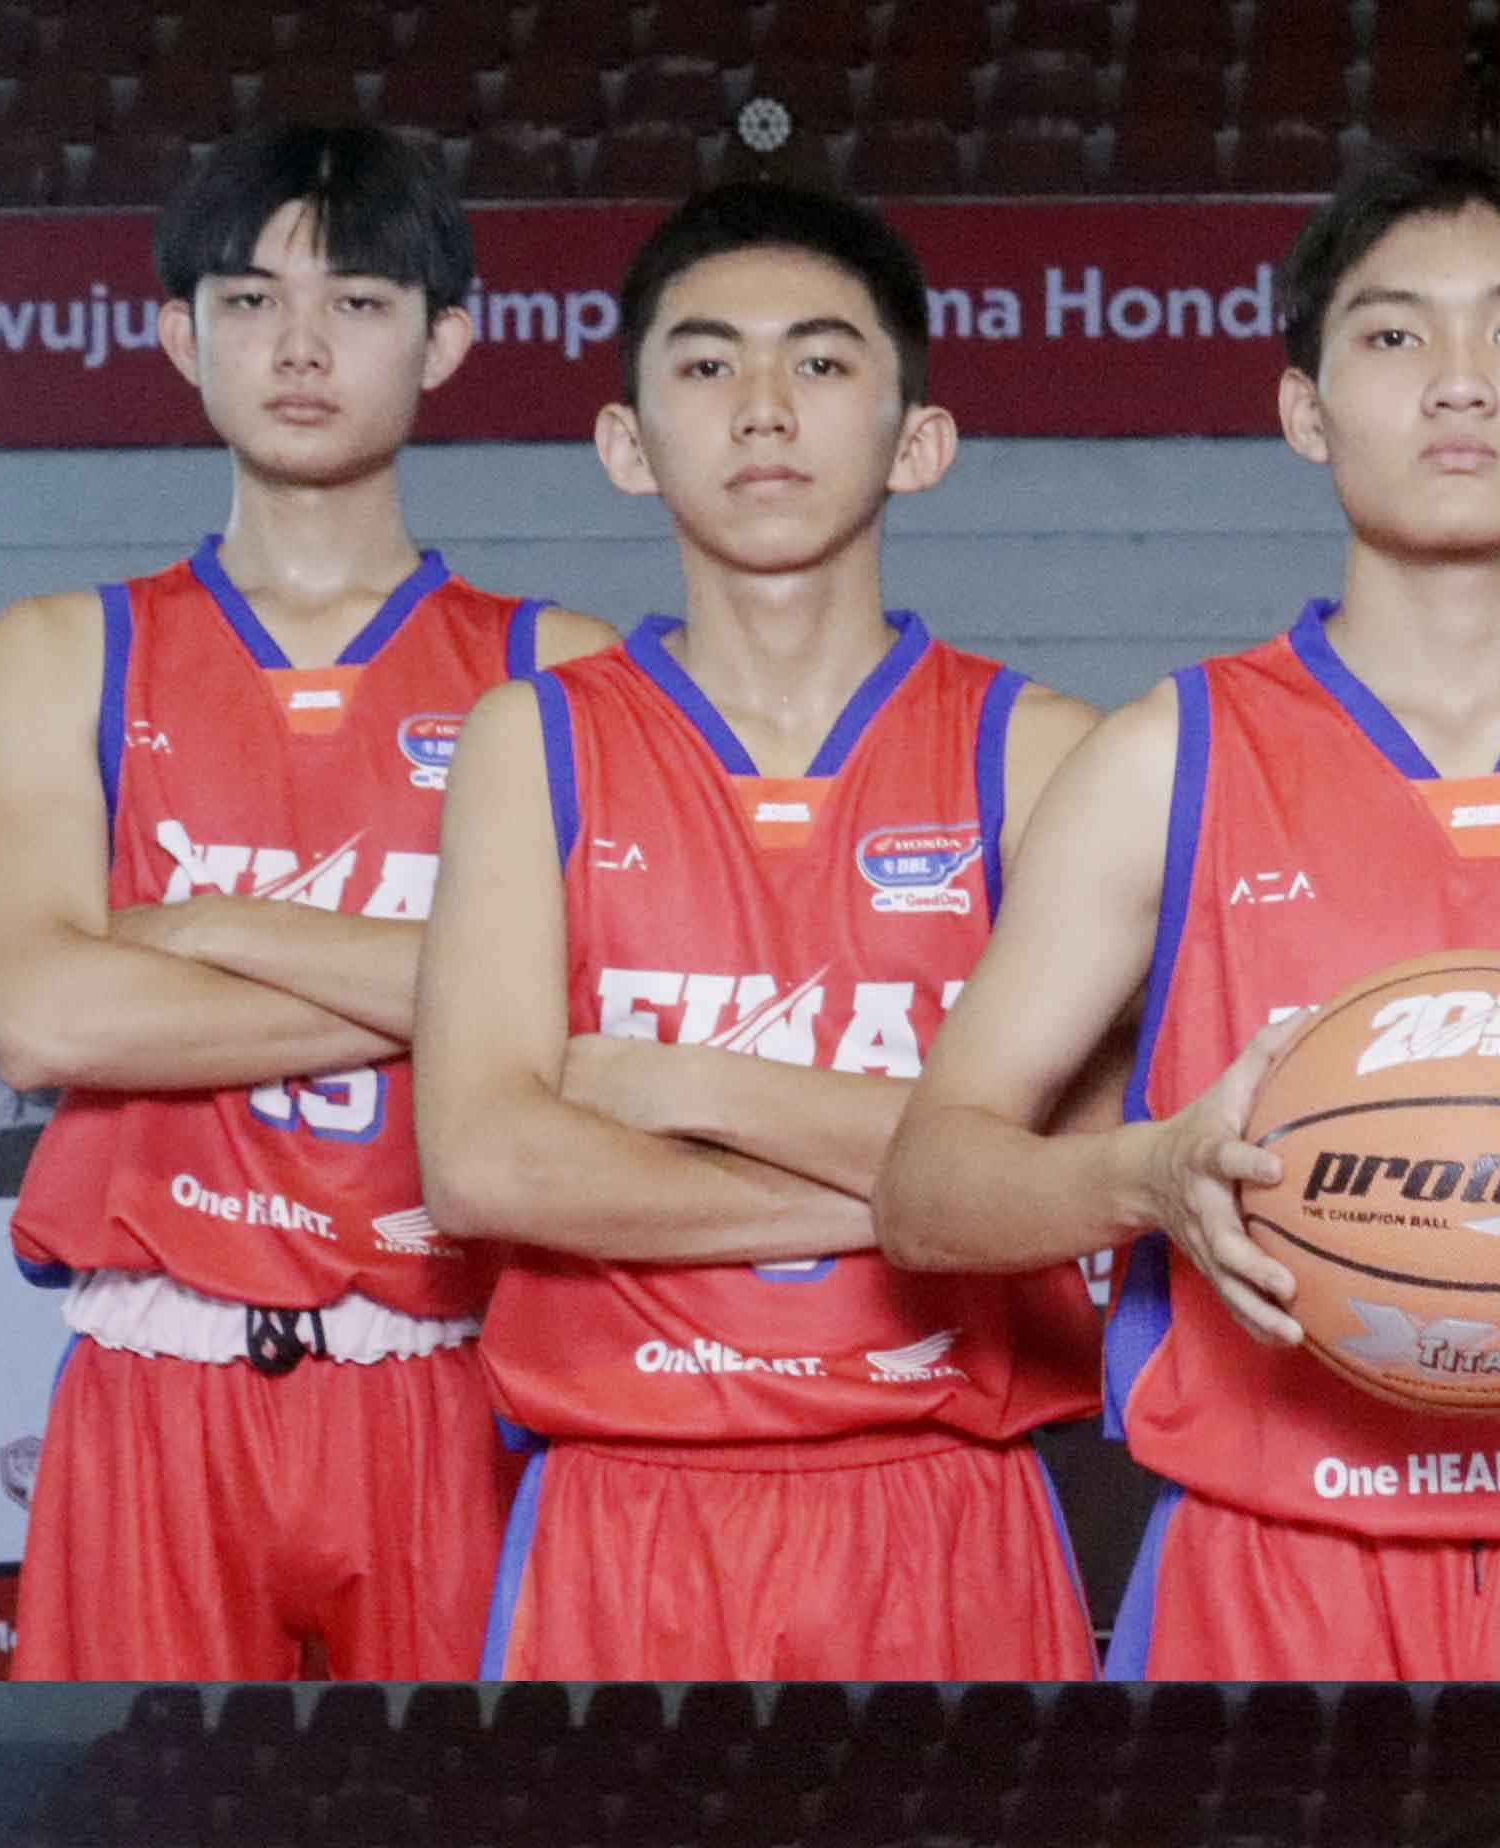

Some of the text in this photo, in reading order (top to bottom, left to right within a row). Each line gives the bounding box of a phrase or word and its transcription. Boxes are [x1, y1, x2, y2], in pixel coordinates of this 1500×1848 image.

[1045, 264, 1285, 340] Hond
[896, 858, 932, 875] DBL
[598, 960, 964, 1080] FINA
[171, 1173, 243, 1223] One
[1329, 1208, 1406, 1227] CHAMPION
[1409, 1216, 1451, 1230] BALL
[1314, 1456, 1398, 1498] One
